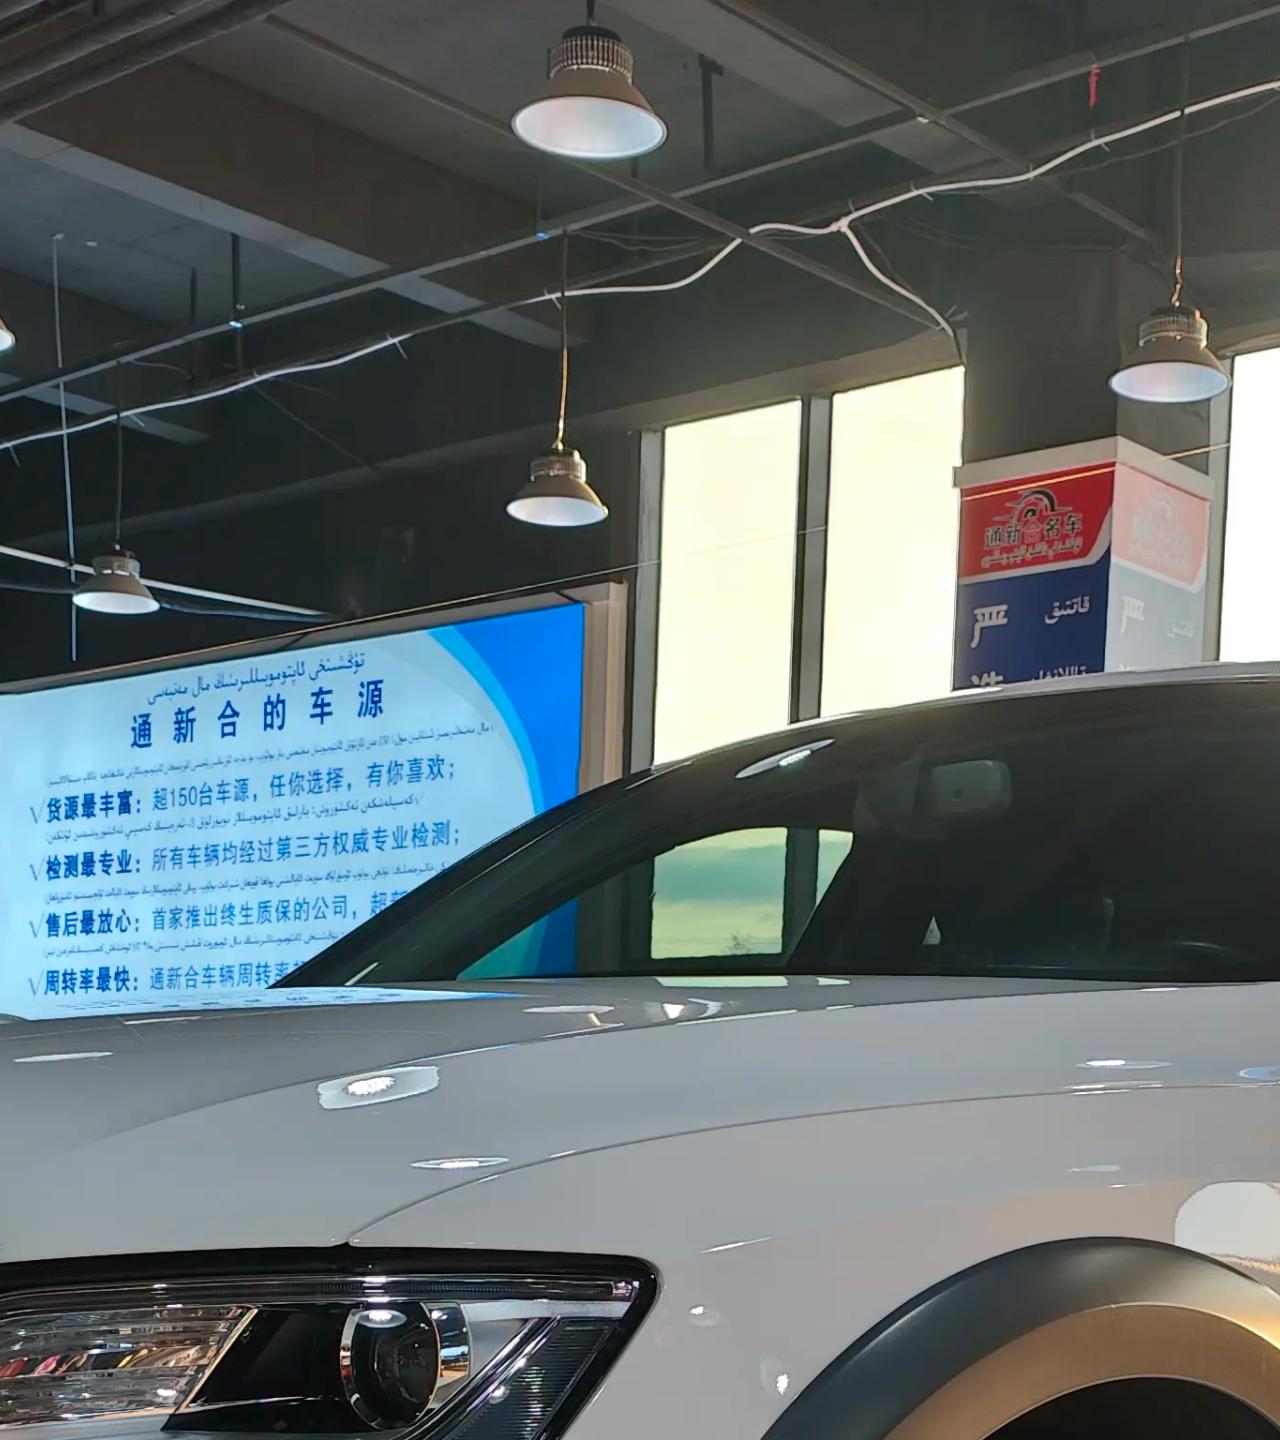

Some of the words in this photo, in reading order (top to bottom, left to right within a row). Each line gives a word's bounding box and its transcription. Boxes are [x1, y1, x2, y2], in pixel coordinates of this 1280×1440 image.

[984, 513, 1084, 550] 通新合名车
[970, 603, 1009, 650] 严
[131, 679, 384, 749] 通新合的车源
